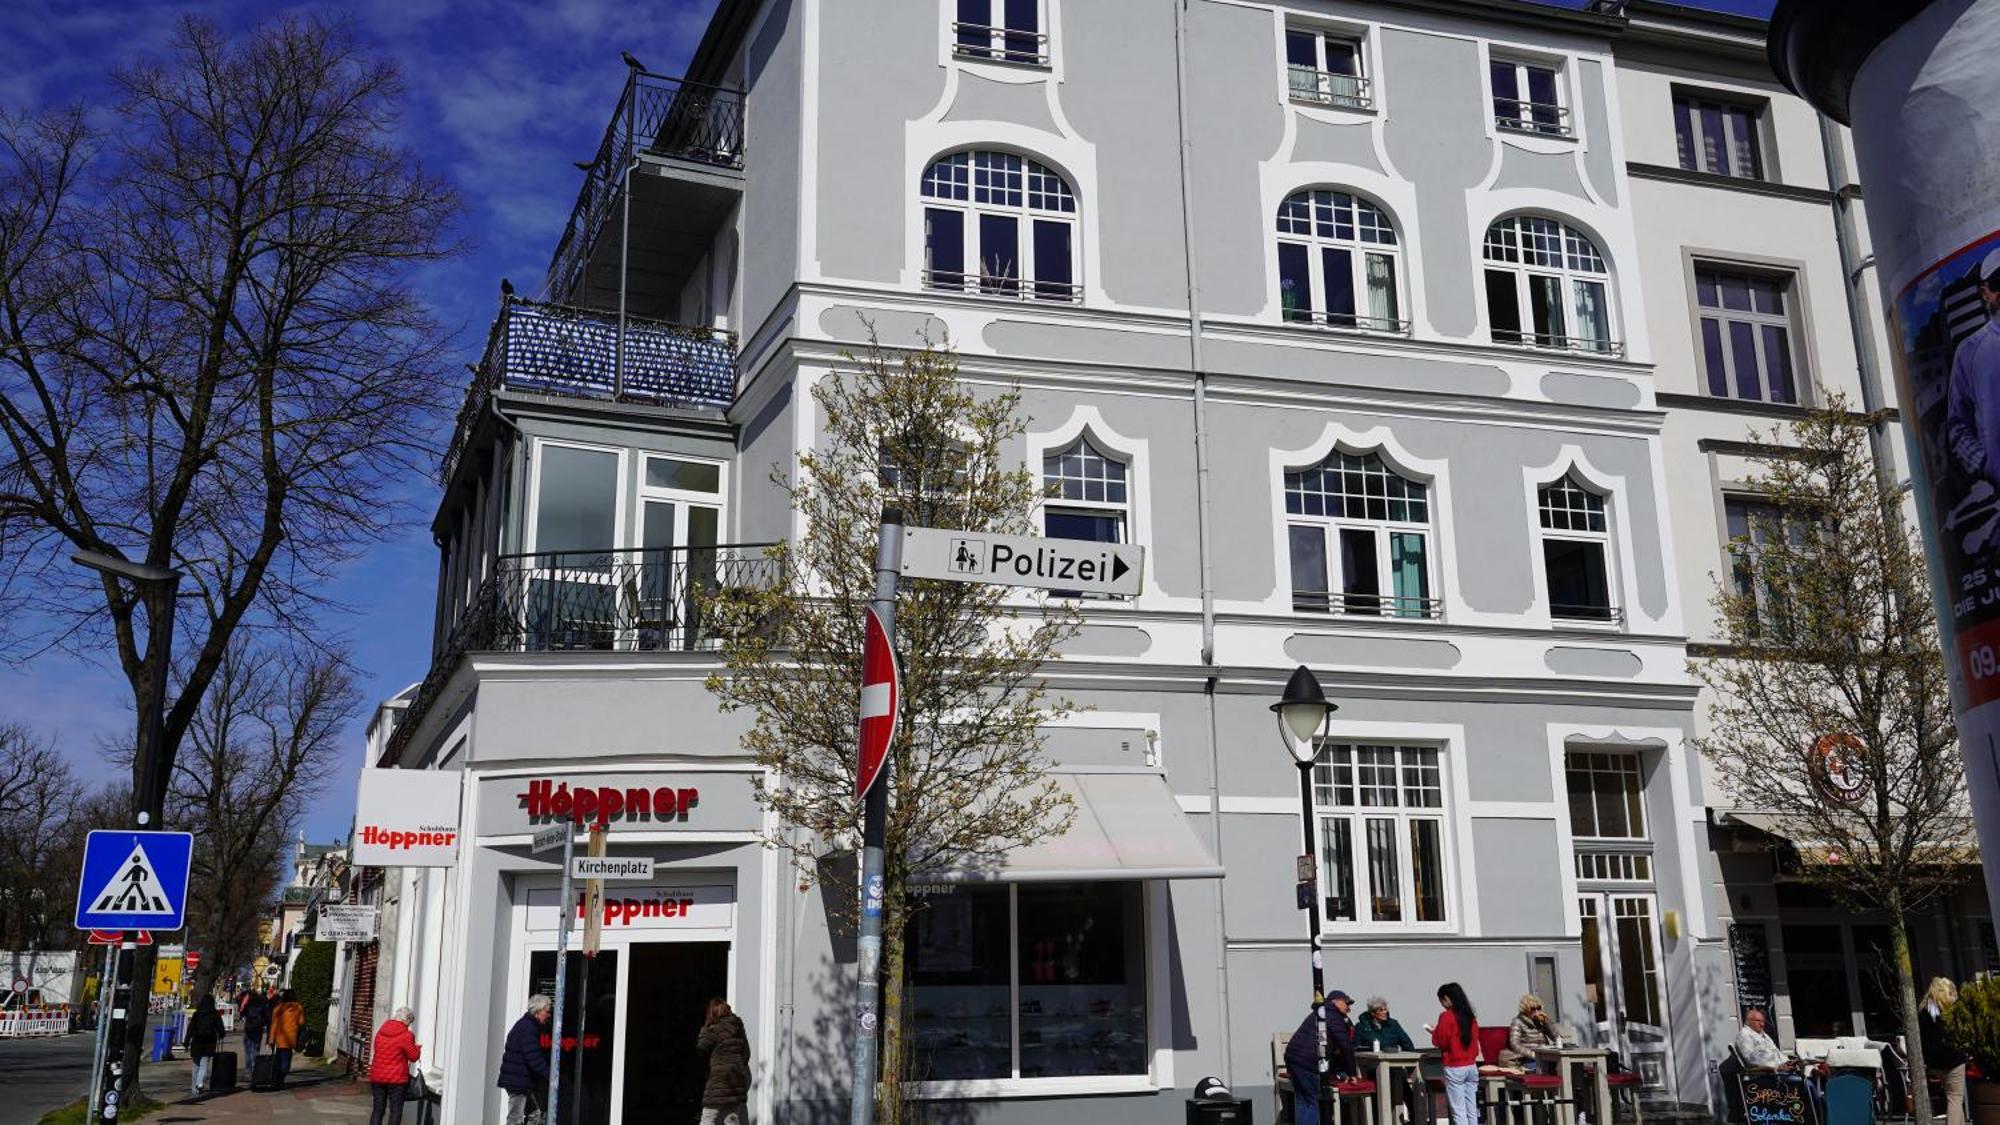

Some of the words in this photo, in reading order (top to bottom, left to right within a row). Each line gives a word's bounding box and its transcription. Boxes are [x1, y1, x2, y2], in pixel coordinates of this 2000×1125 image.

[991, 544, 1106, 582] Polizei
[1962, 568, 1988, 591] 25
[1954, 596, 1976, 618] DIE
[578, 860, 648, 876] Kirchenplatz
